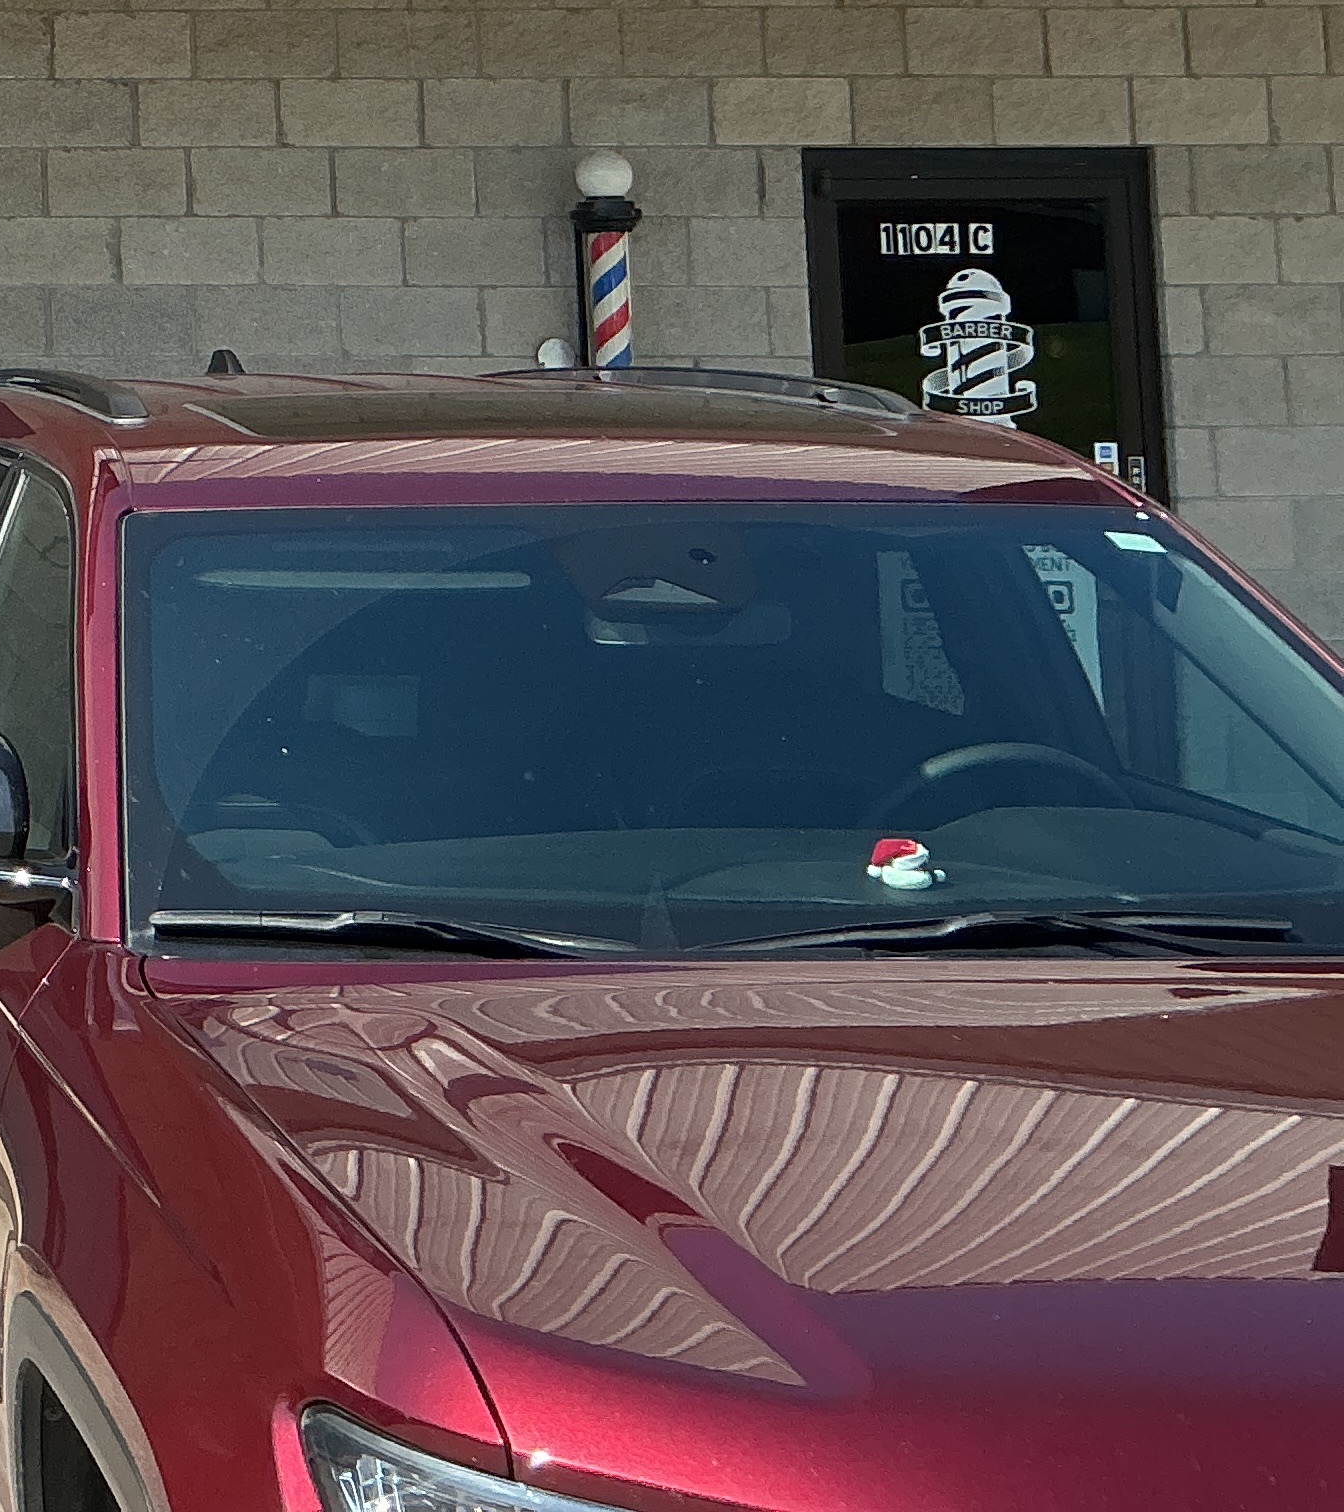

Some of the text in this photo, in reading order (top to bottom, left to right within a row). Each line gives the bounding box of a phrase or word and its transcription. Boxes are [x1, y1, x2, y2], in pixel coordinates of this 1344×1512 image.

[881, 224, 991, 254] 1104 C
[939, 322, 1014, 340] BARBER
[956, 399, 1005, 415] SHOP
